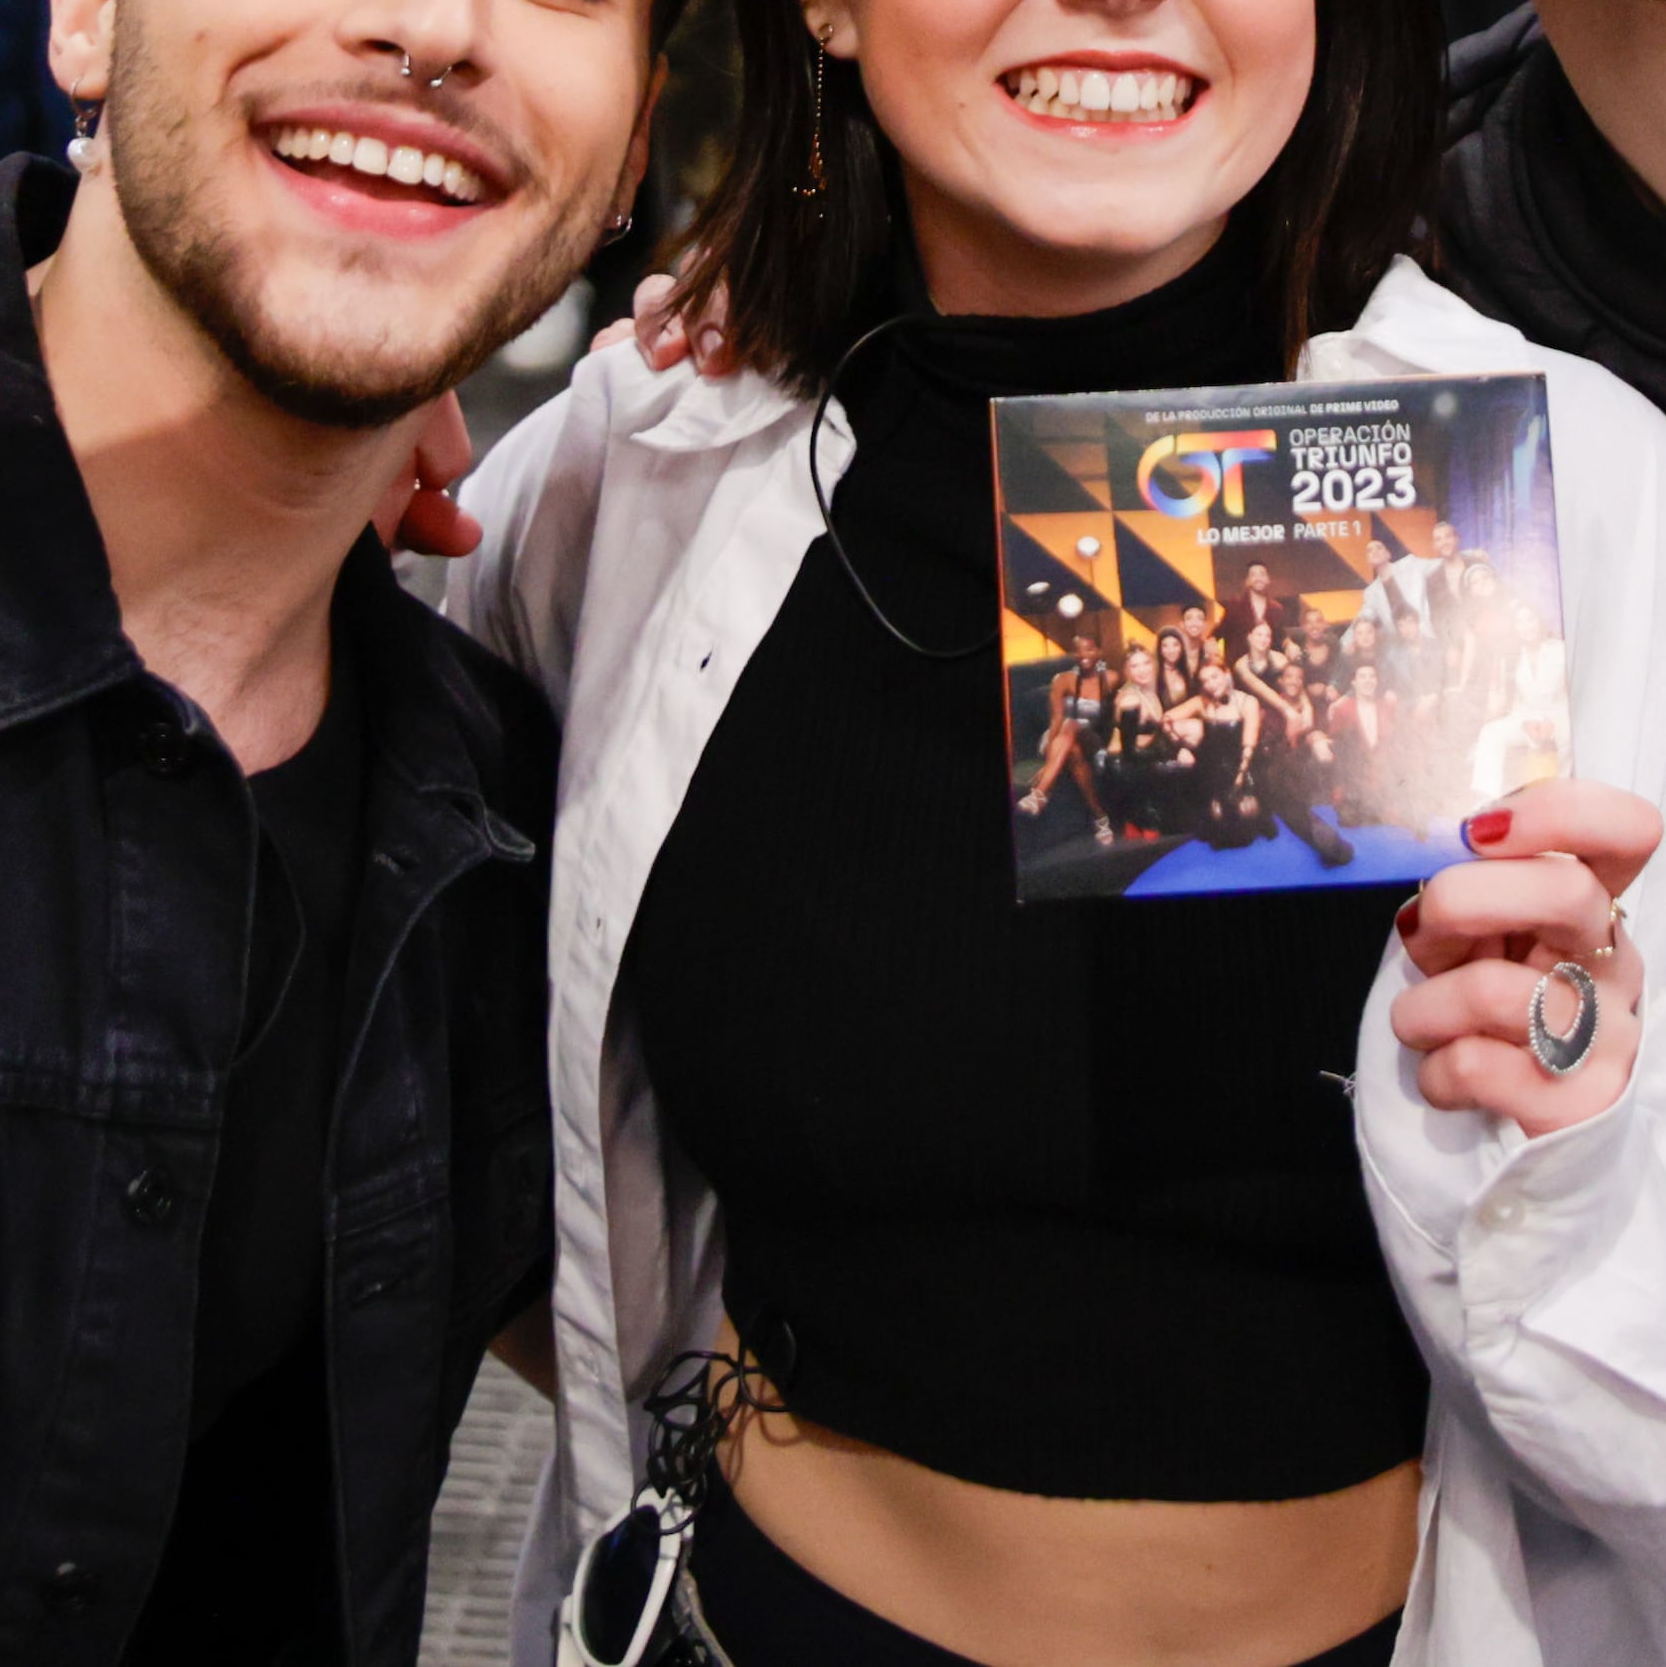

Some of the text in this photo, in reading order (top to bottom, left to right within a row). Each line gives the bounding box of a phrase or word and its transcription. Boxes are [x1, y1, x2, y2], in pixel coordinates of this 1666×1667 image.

[1146, 399, 1399, 423] DE LA PRODUCCIÓN ORIGINAL DE PRIME VIDEO
[1289, 420, 1411, 446] OPERACIÓN
[1290, 443, 1412, 470] TRIUNFO
[1137, 429, 1277, 520] OT
[1291, 466, 1416, 513] 2023
[1197, 520, 1362, 544] LO MEJOR PARTE 1
